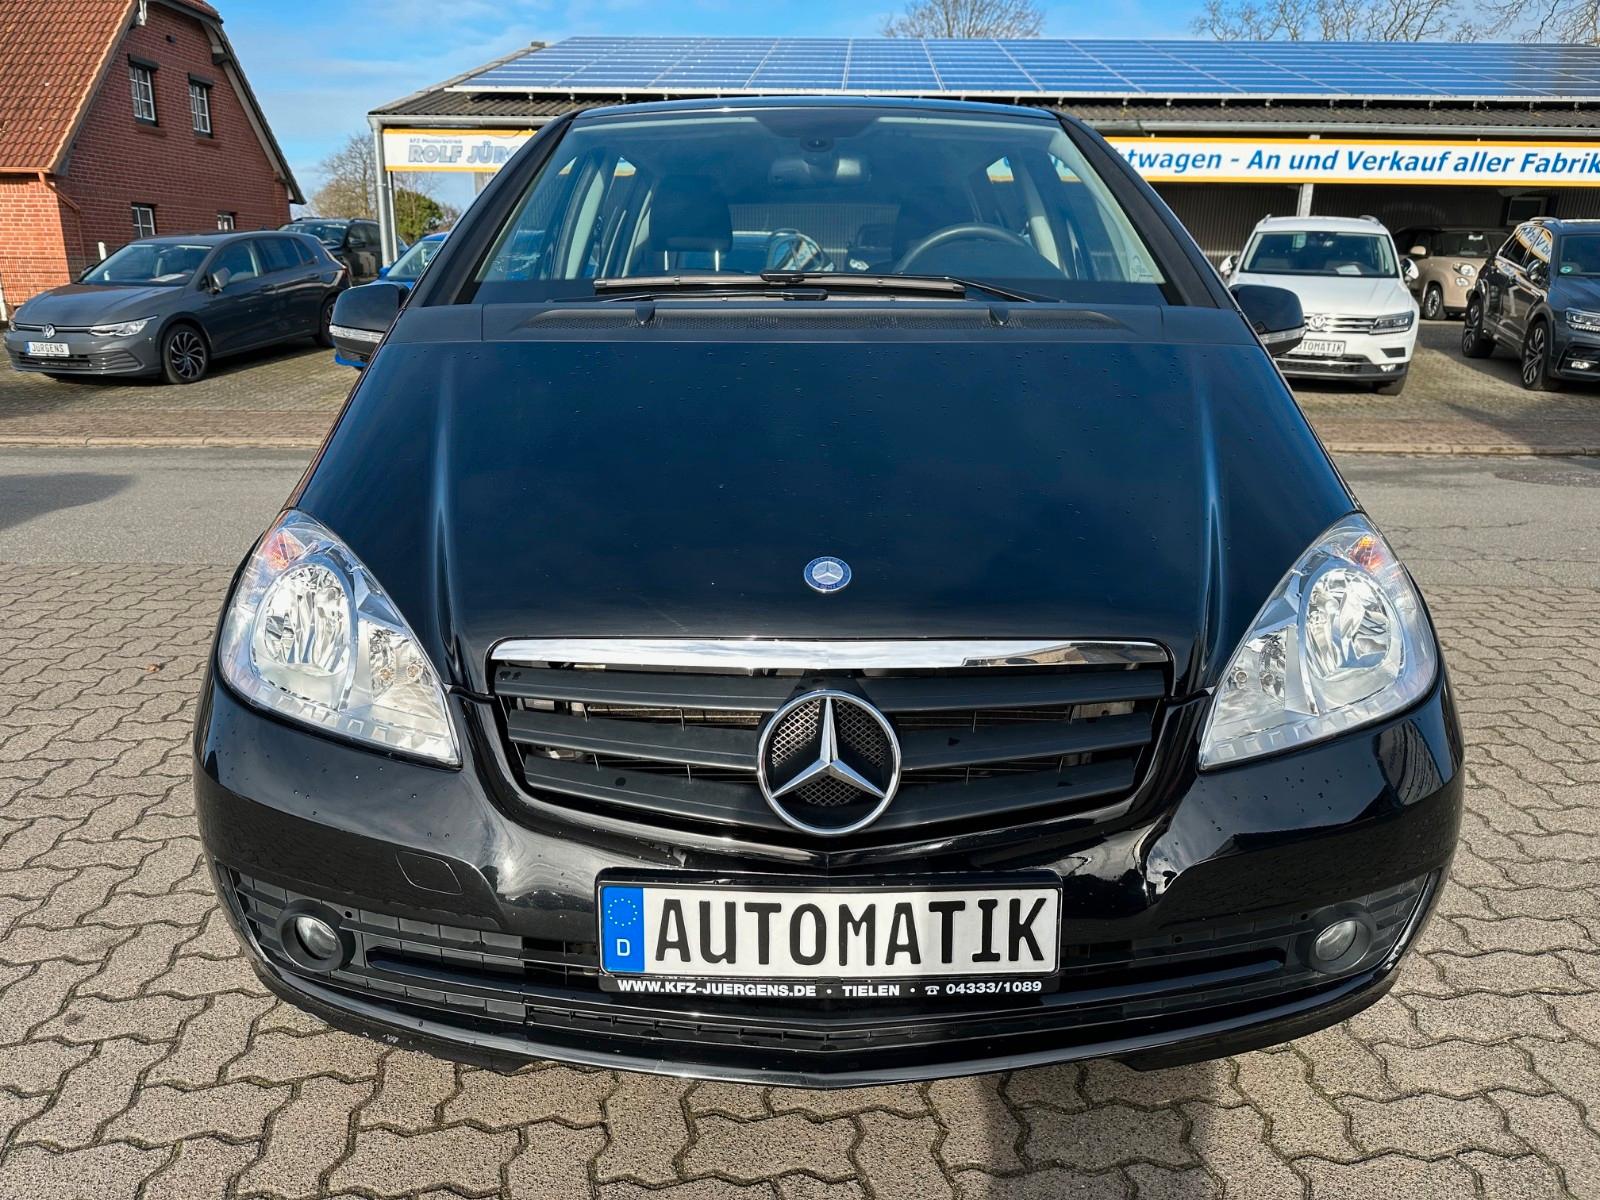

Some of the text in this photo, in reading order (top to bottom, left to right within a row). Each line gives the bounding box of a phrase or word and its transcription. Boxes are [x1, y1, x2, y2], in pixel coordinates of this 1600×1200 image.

[408, 145, 462, 163] ROLF
[1115, 148, 1222, 173] twagen
[1247, 149, 1281, 170] An
[1289, 150, 1340, 170] und
[1347, 150, 1451, 171] Verkauf
[1453, 151, 1515, 173] aller
[1520, 152, 1600, 174] Fabrik
[655, 897, 1048, 967] AUTOMATIK
[616, 938, 631, 957] D
[616, 979, 1043, 998] WWW.KFZ-JUERGENS.DE TIELEN 04333/1089
